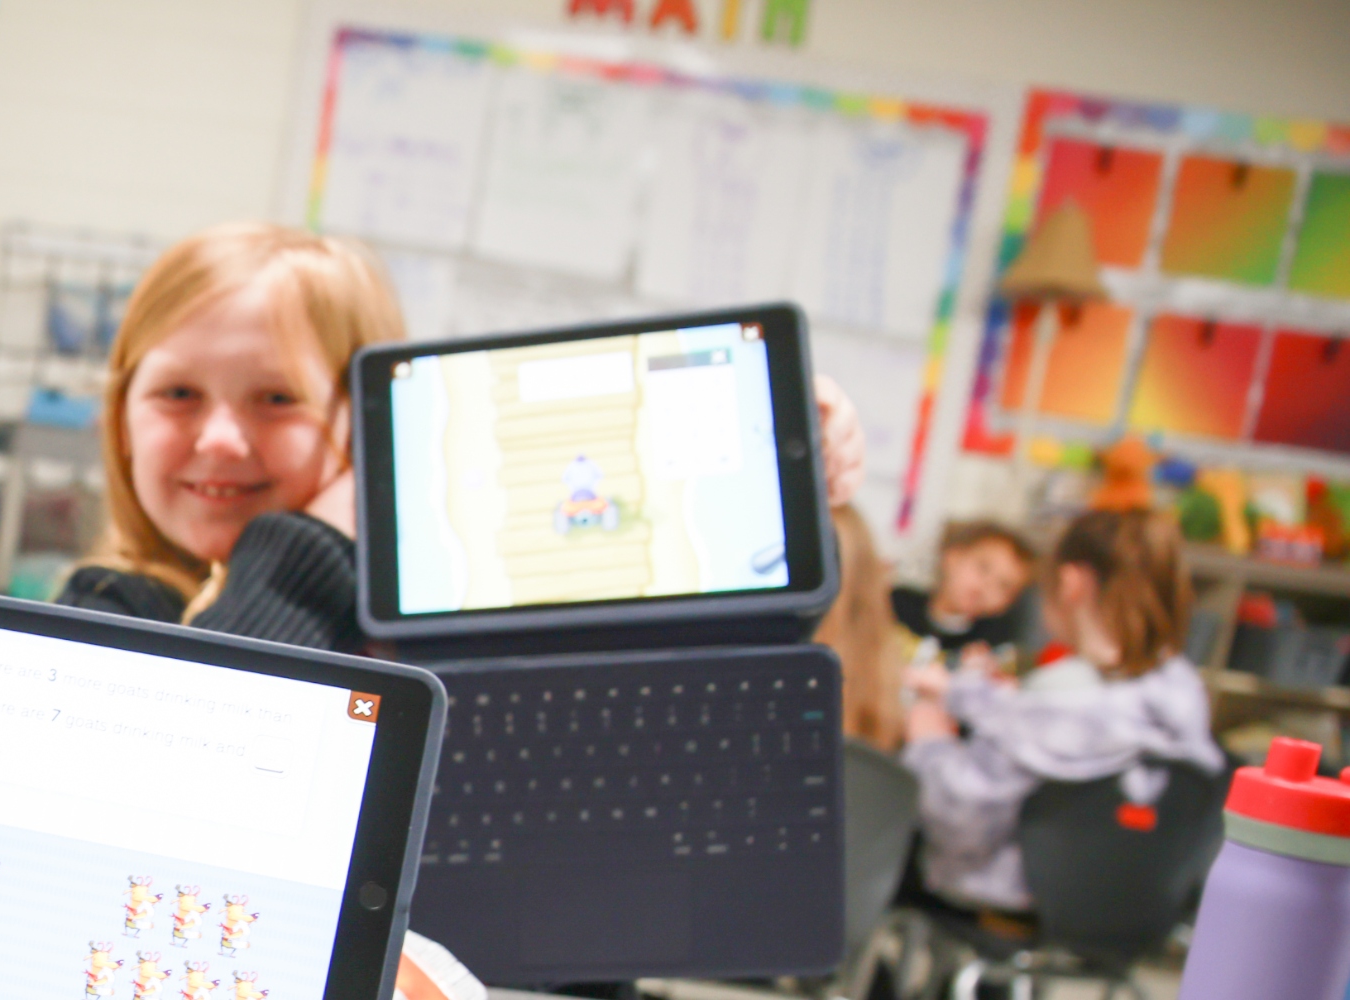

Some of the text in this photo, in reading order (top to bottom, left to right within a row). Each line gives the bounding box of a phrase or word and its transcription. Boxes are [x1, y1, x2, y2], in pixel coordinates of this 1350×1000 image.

[18, 667, 42, 680] are
[48, 668, 58, 682] 3
[63, 674, 102, 689] more
[107, 681, 149, 699] goats
[155, 688, 216, 714] drinking
[222, 701, 251, 715] milk
[259, 707, 292, 723] than
[20, 707, 45, 720] are
[51, 708, 62, 722] 7
[65, 714, 107, 732] goats
[113, 722, 174, 747] drinking
[180, 735, 210, 749] milk
[215, 742, 246, 757] and
